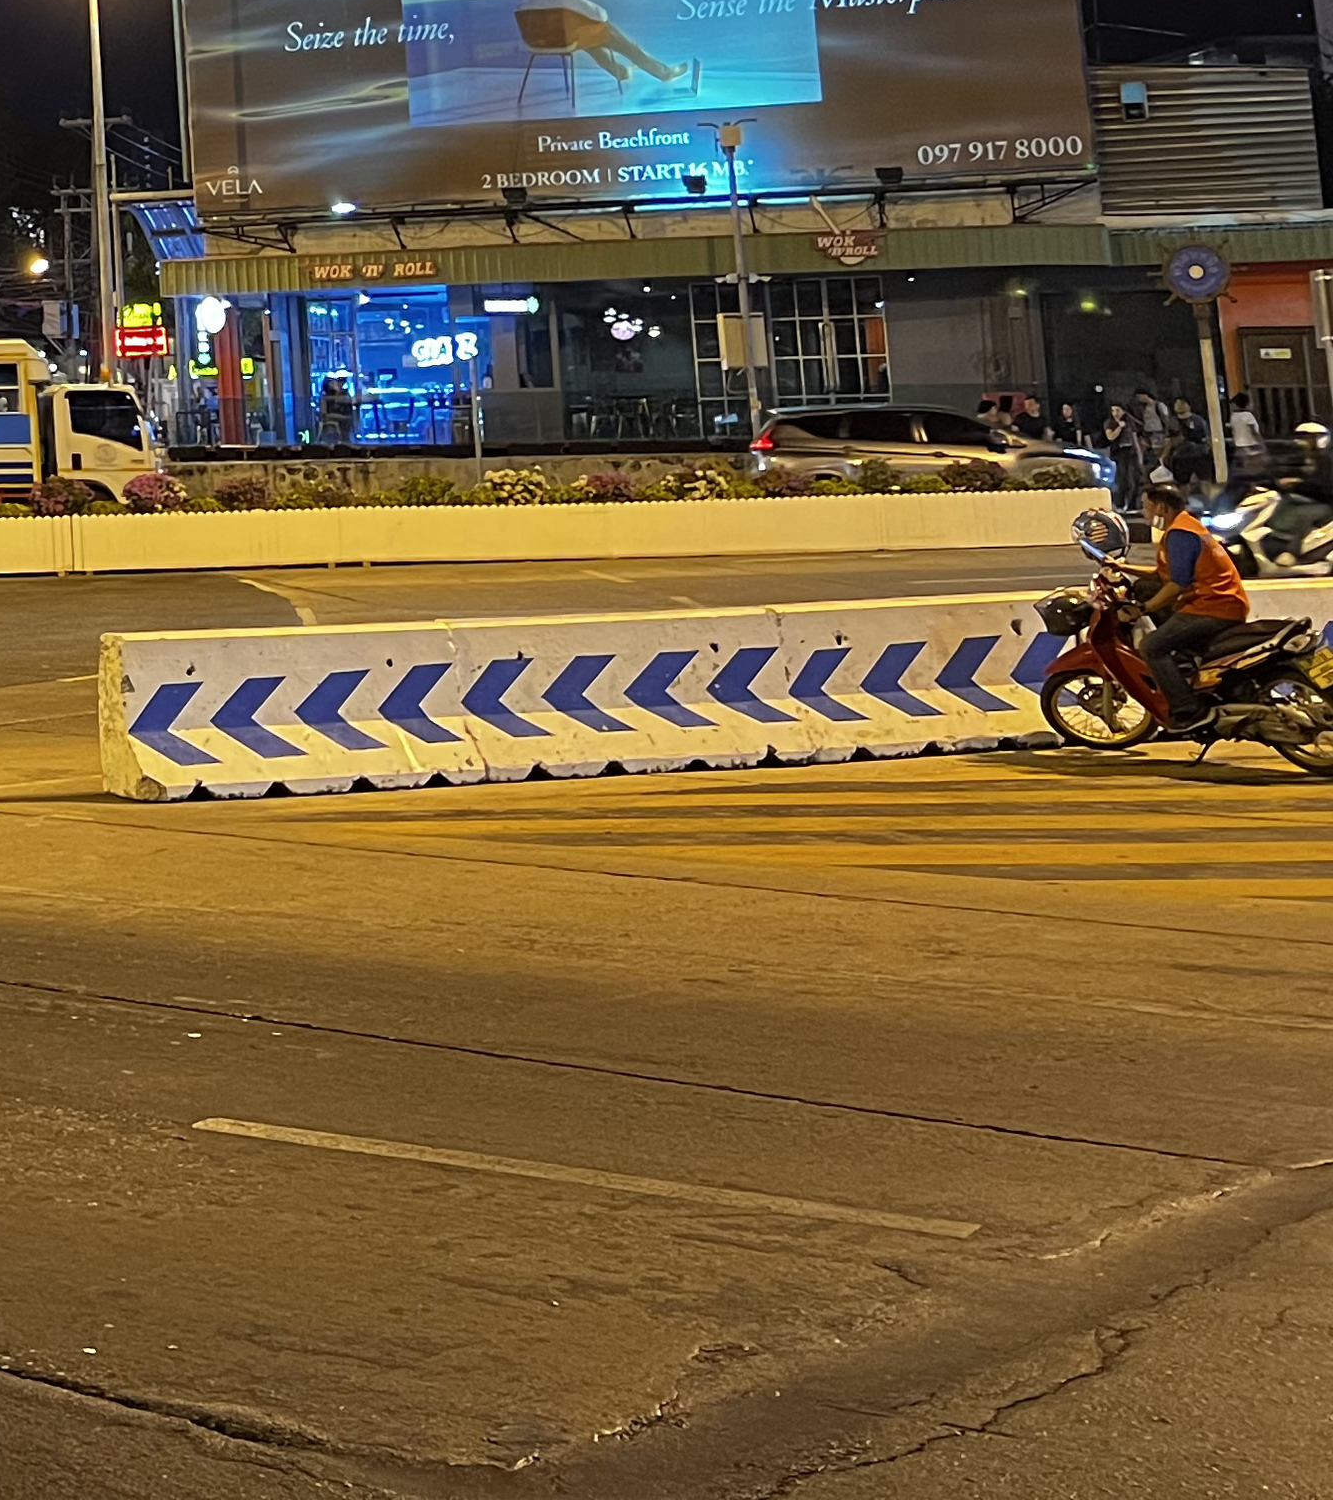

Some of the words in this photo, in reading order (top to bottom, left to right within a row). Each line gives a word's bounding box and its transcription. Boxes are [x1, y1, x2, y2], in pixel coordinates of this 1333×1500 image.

[284, 20, 346, 52] Seize
[353, 16, 388, 47] the
[396, 14, 456, 45] time,
[537, 135, 594, 153] Private
[598, 128, 690, 150] Beachfront
[917, 143, 961, 166] 097
[968, 140, 1008, 162] 917
[1014, 135, 1083, 159] 8000
[205, 179, 264, 196] VELA
[482, 173, 492, 189] 2
[496, 168, 601, 189] BEDROOM
[617, 163, 685, 184] START
[816, 235, 856, 248] WOK
[314, 264, 353, 279] WOK
[393, 261, 435, 276] ROLL
